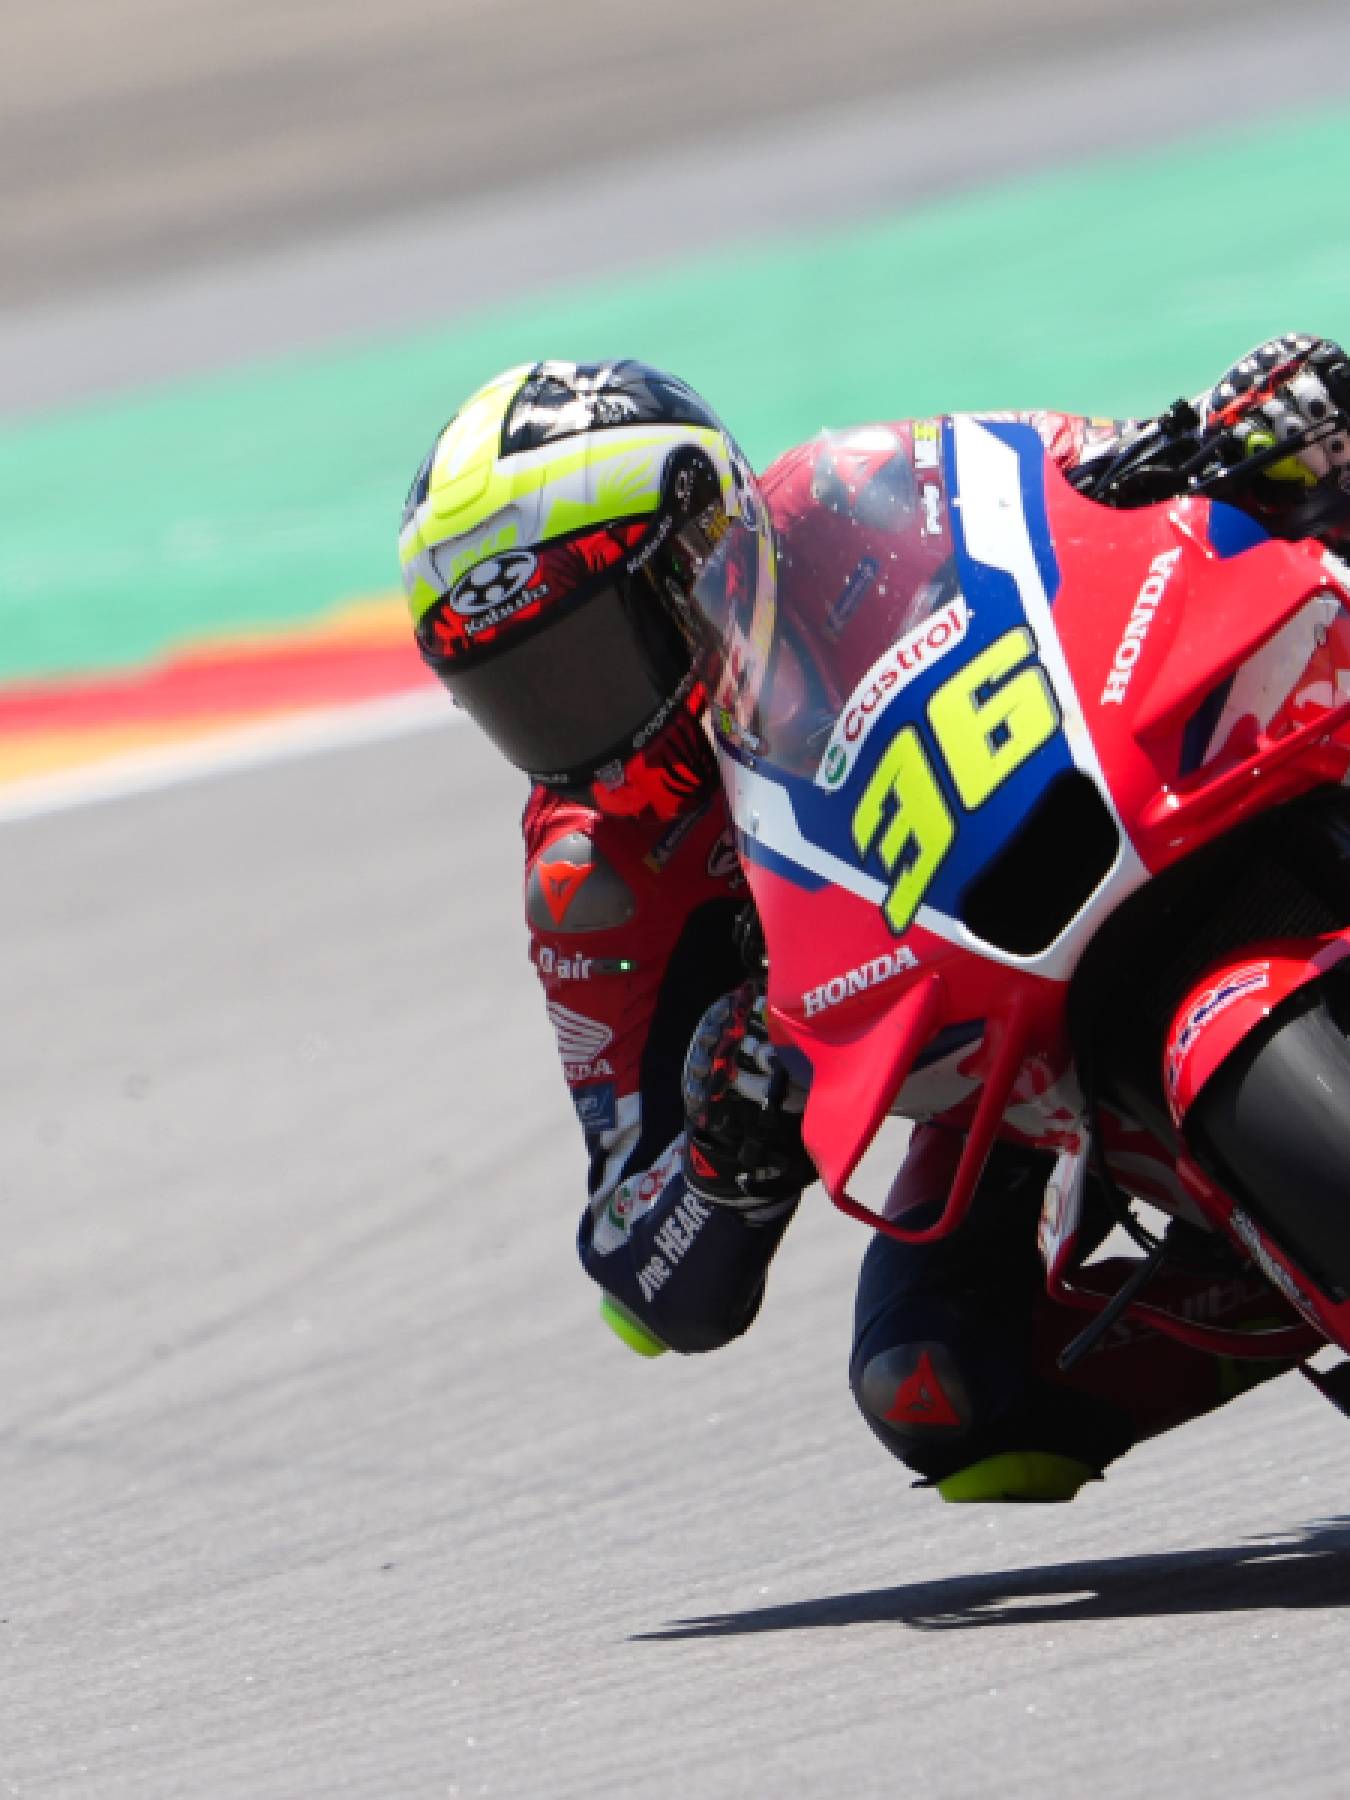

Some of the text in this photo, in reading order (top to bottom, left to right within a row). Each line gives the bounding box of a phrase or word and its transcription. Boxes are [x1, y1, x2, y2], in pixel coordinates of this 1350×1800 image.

[844, 608, 963, 742] Castrol
[1100, 545, 1182, 705] HONDA
[851, 624, 1064, 935] 36
[802, 944, 919, 1018] HONDA
